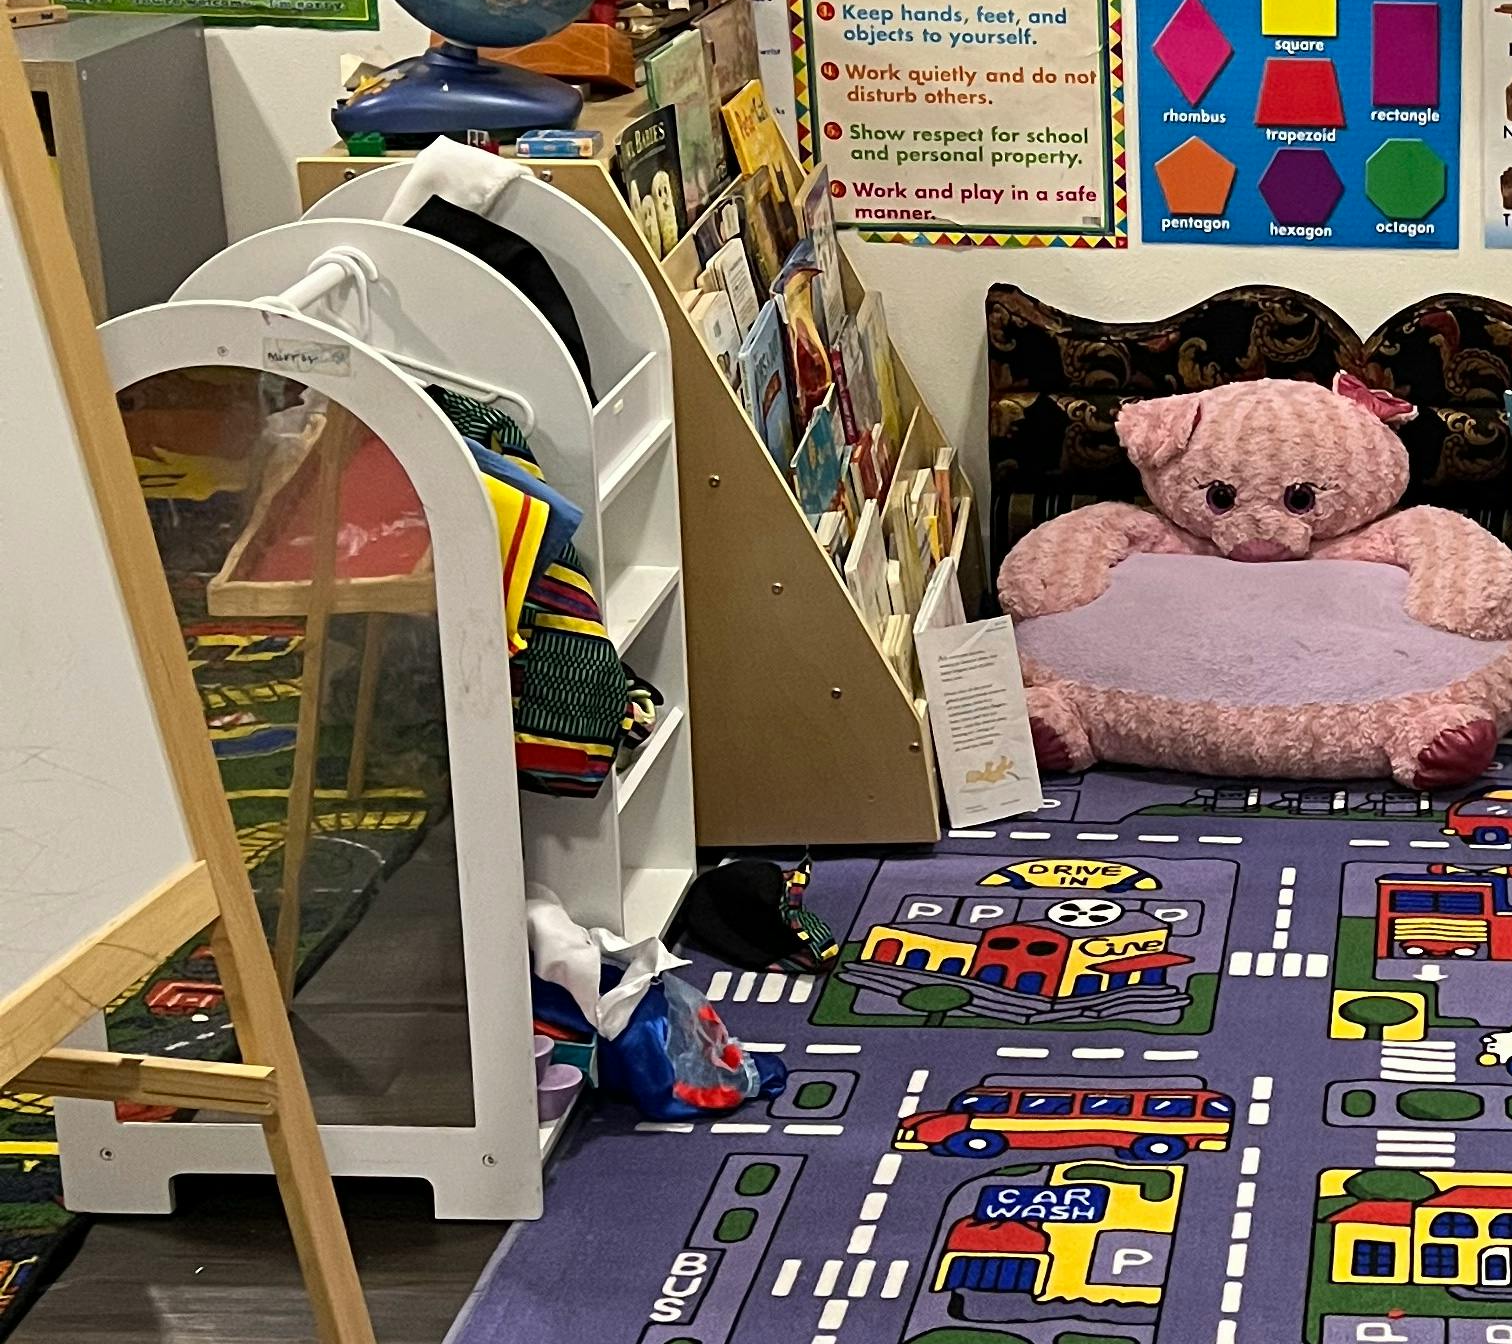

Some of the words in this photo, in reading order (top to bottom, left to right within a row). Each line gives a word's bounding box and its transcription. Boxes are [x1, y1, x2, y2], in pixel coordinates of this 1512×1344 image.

[1274, 38, 1325, 54] square
[845, 64, 901, 81] Work
[908, 66, 977, 85] quietly
[986, 67, 1024, 83] and
[1032, 68, 1057, 84] do
[1065, 69, 1097, 85] not
[847, 86, 917, 103] disturb
[924, 88, 993, 105] others.
[1163, 109, 1227, 124] rhombus
[1370, 108, 1440, 125] rectangle
[1265, 128, 1336, 145] trapezoid
[1161, 216, 1231, 233] pentagon
[1269, 222, 1333, 239] hexagon
[1375, 221, 1436, 236] octagon
[1027, 862, 1122, 880] DRIVE
[1057, 872, 1090, 889] IN
[907, 900, 944, 921] P
[969, 904, 1005, 924] P
[1078, 937, 1166, 958] Cine
[997, 1187, 1092, 1206] CAR
[986, 1203, 1097, 1222] WASH
[1113, 1249, 1154, 1275] P
[648, 1251, 708, 1323] BUS
